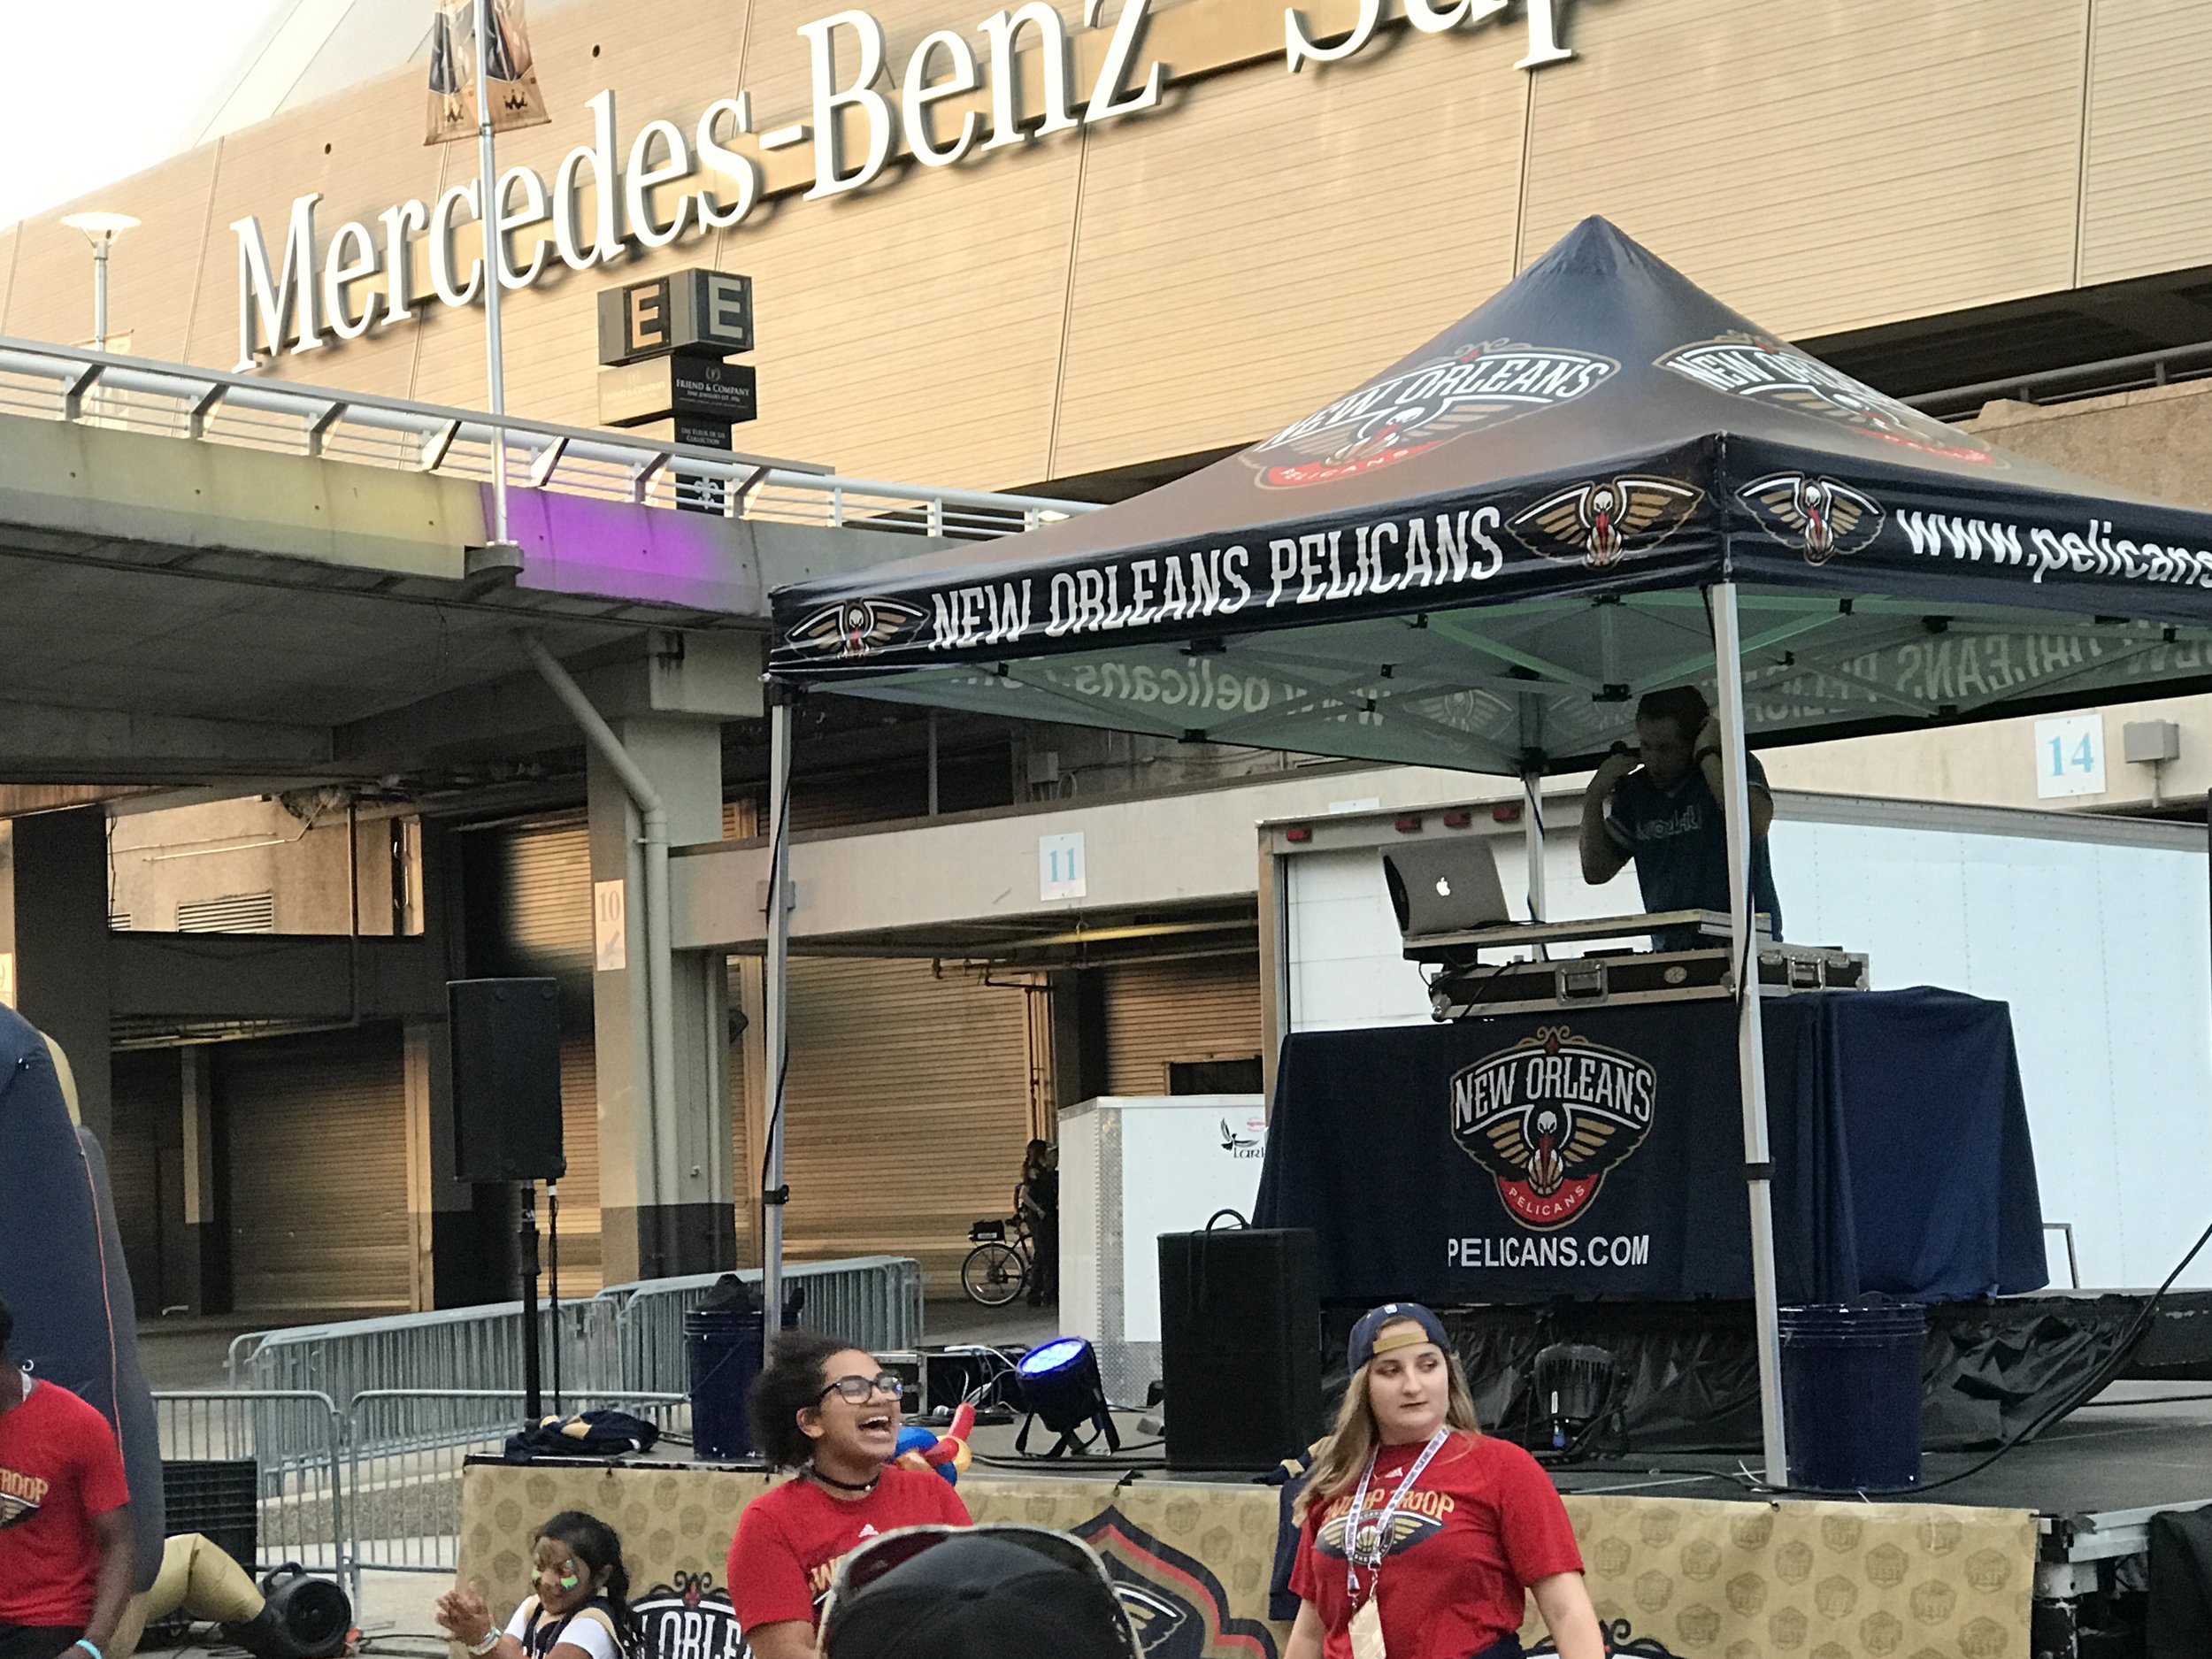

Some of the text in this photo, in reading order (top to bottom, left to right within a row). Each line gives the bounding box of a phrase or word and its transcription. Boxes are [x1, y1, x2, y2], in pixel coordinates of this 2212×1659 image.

[229, 0, 1164, 373] Mercedes-Benz
[631, 284, 662, 349] E
[709, 276, 742, 339] E
[1398, 360, 1609, 404] ORLEANS
[928, 505, 1503, 651] NEW ORLEANS PELICANS
[2047, 732, 2094, 776] 14
[1049, 847, 1077, 883] 11
[598, 890, 621, 922] 10
[1455, 1056, 1653, 1130] NEW ORLEANS
[1509, 1185, 1586, 1217] PELICANS
[1448, 1234, 1650, 1268] PELICANS.COM
